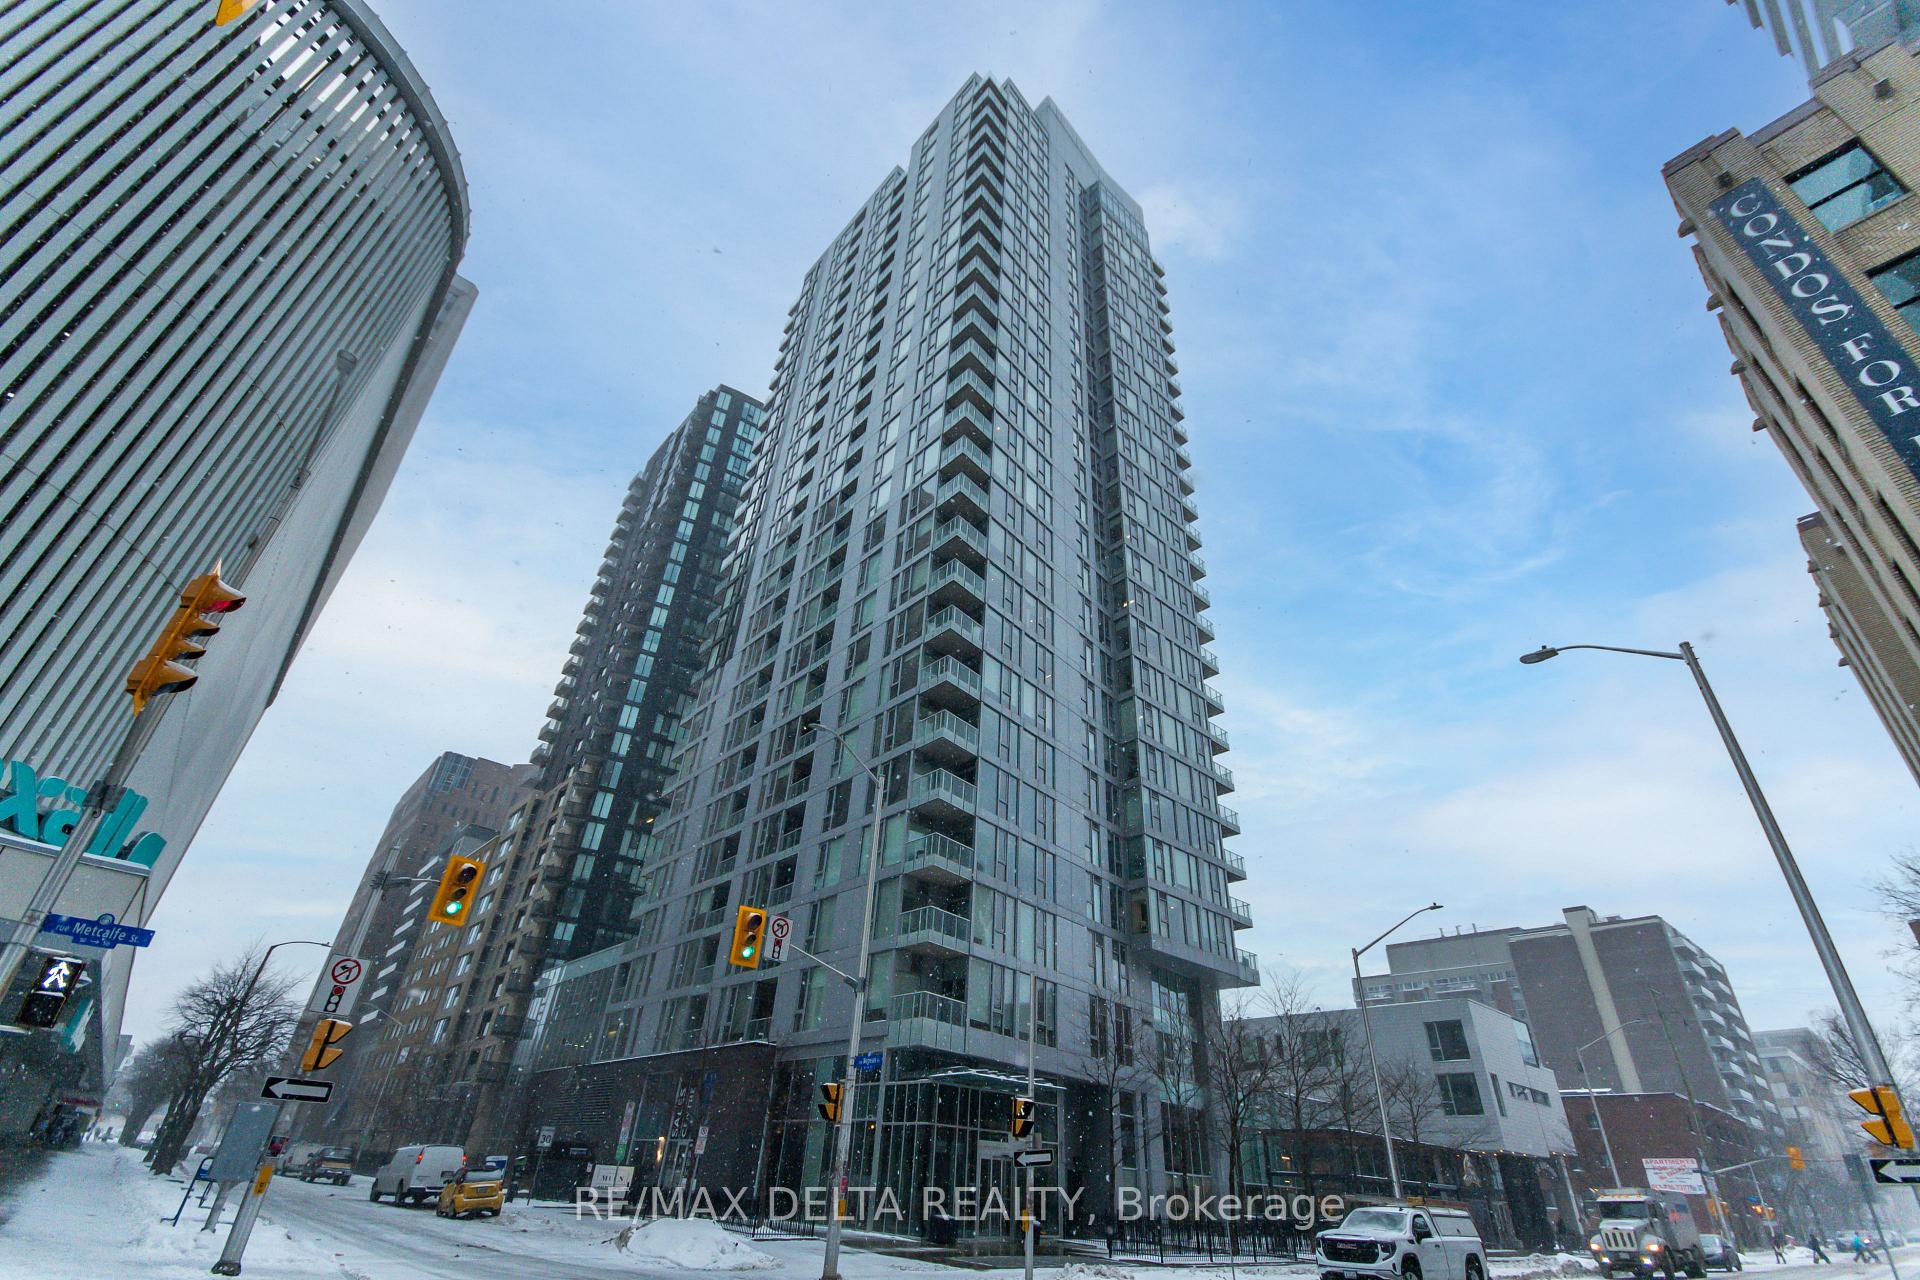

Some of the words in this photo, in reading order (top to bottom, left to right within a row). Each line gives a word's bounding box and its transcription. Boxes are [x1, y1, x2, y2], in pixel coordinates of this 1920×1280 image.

[1729, 193, 1855, 327] CONDOS
[1839, 332, 1920, 417] FOR
[55, 924, 70, 932] rue
[72, 922, 126, 941] Metcalfe
[540, 1134, 551, 1144] 30
